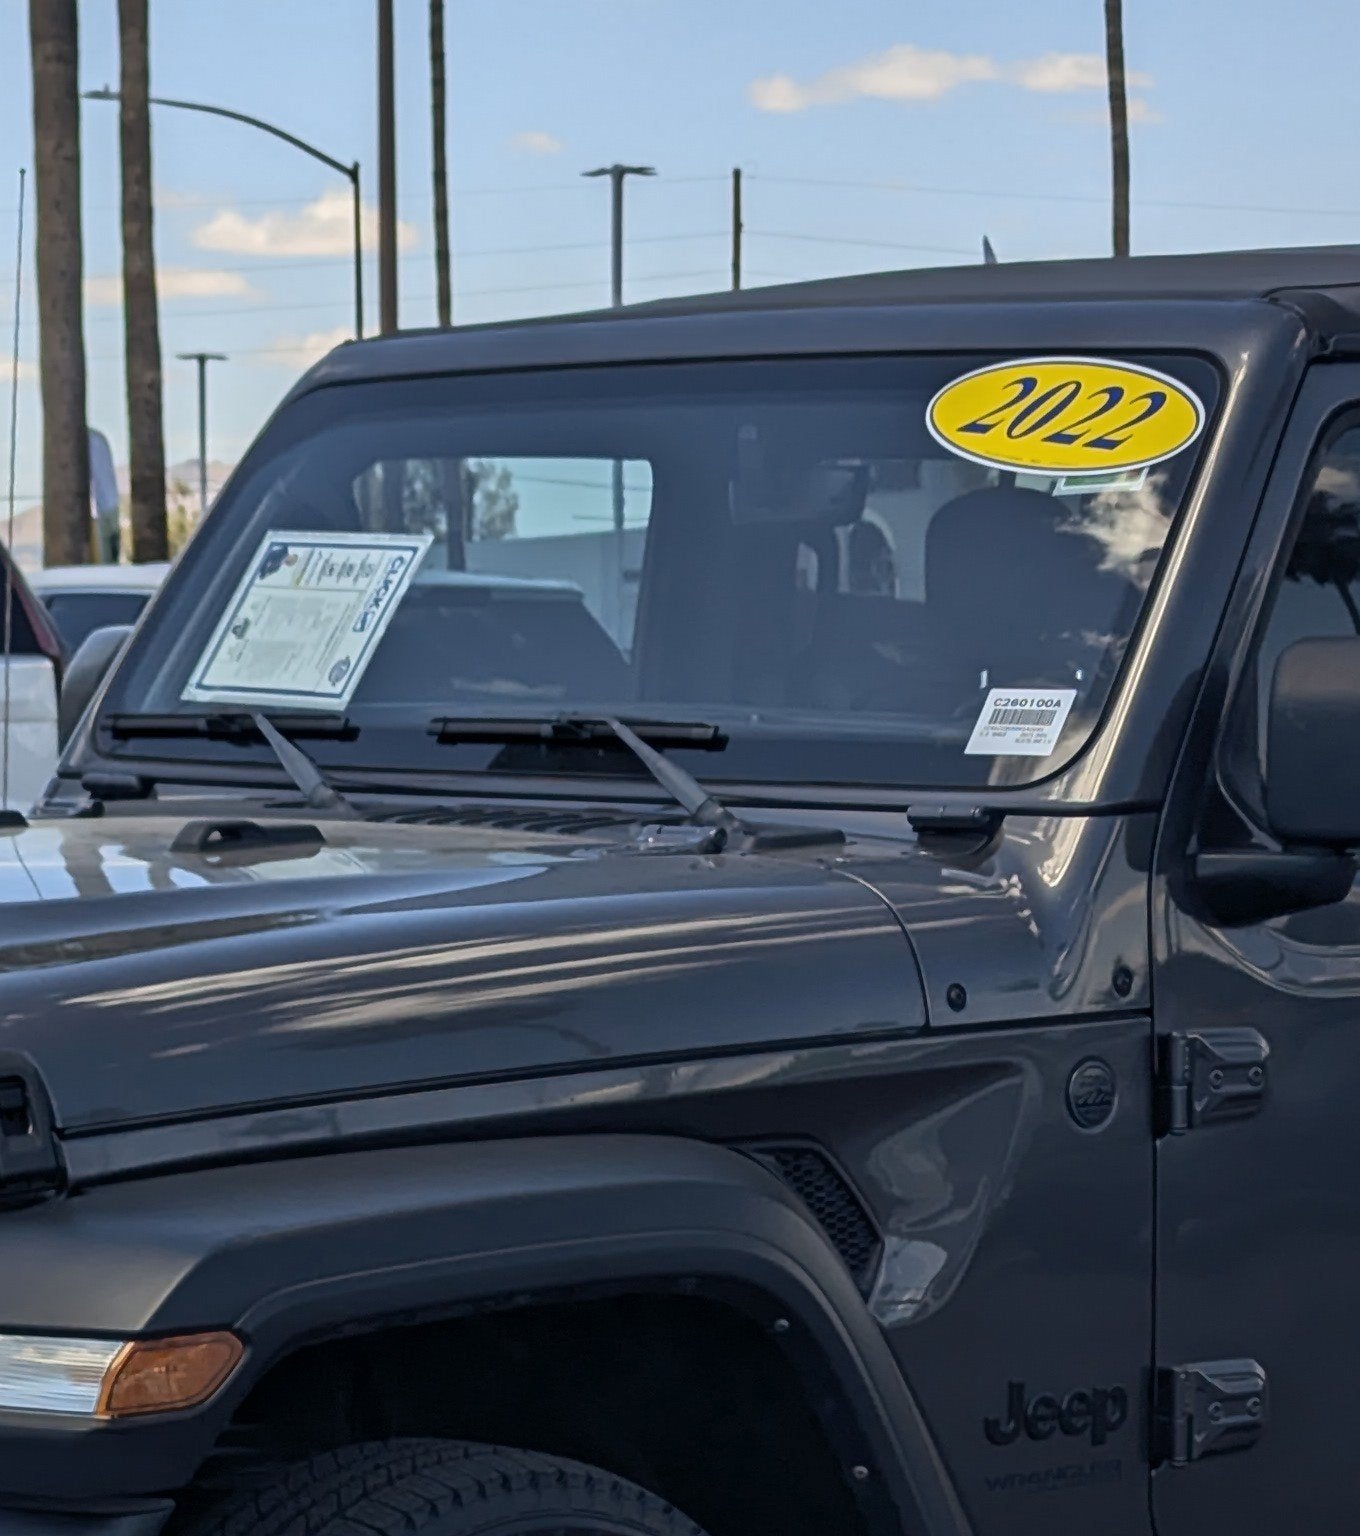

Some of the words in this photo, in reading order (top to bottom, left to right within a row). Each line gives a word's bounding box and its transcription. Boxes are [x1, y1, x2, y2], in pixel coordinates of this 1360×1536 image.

[956, 377, 1167, 451] 2022
[993, 698, 1062, 709] C260100A
[984, 1380, 1128, 1446] Jeep
